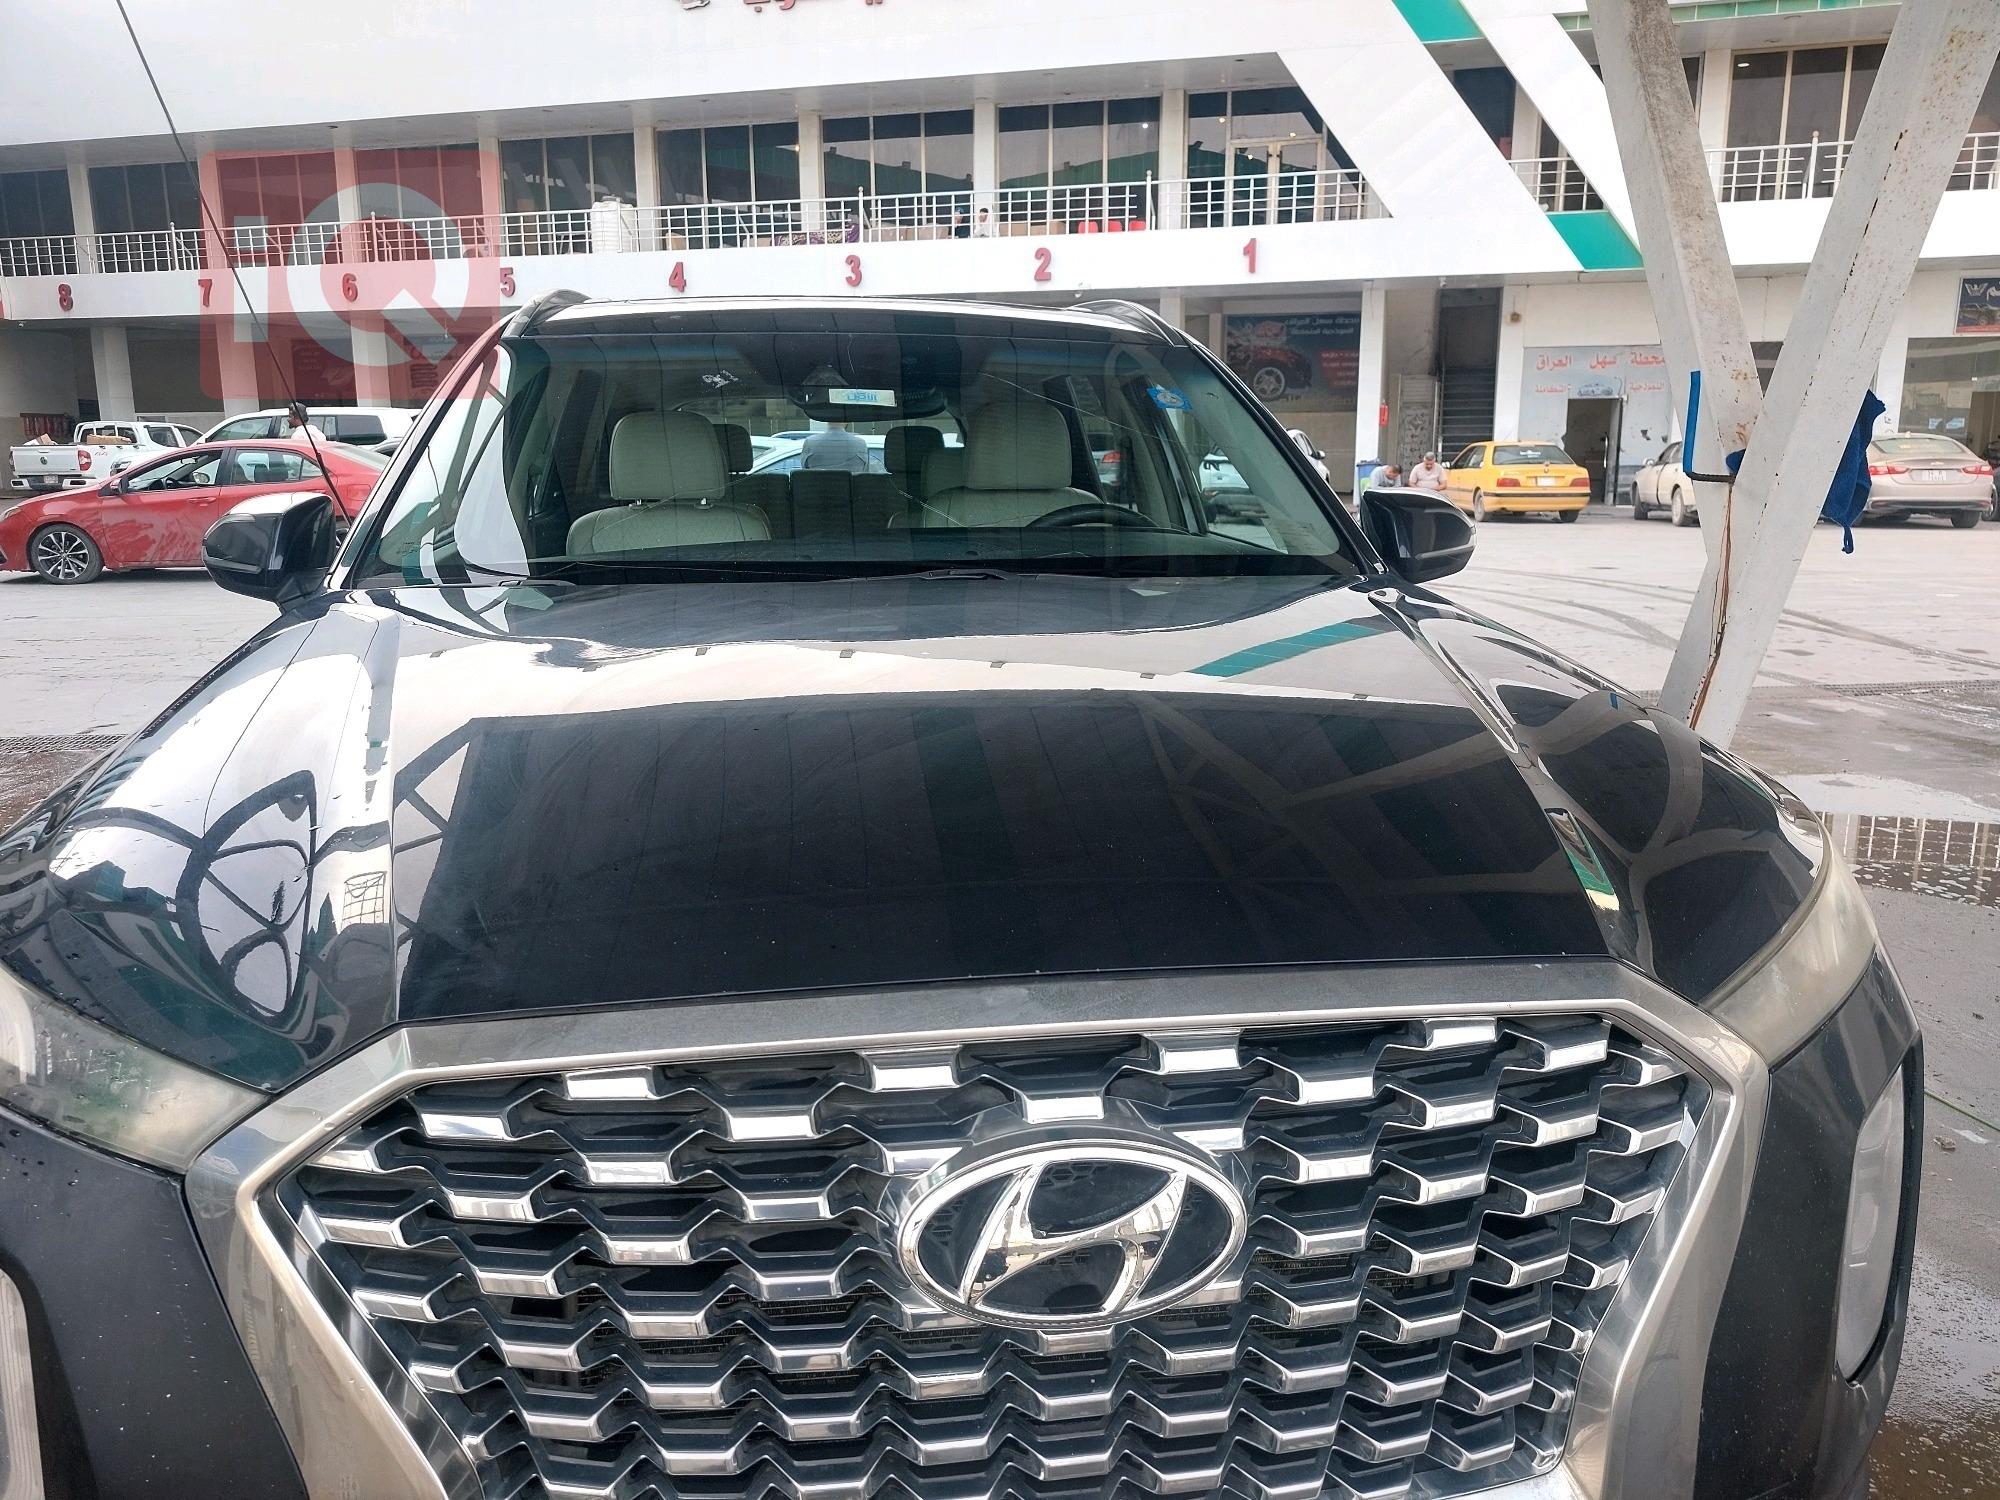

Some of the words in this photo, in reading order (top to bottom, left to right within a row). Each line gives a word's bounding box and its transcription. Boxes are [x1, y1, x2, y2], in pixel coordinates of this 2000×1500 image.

[1034, 247, 1052, 282] 2
[1243, 239, 1257, 273] 1
[500, 268, 515, 297] 5
[669, 262, 686, 292] 4
[845, 255, 862, 287] 3
[58, 284, 73, 311] 8
[198, 279, 213, 307] 7
[343, 273, 358, 302] 6
[1536, 353, 1573, 371] العراق
[1589, 354, 1617, 369] سهل
[1631, 352, 1665, 366] محطة
